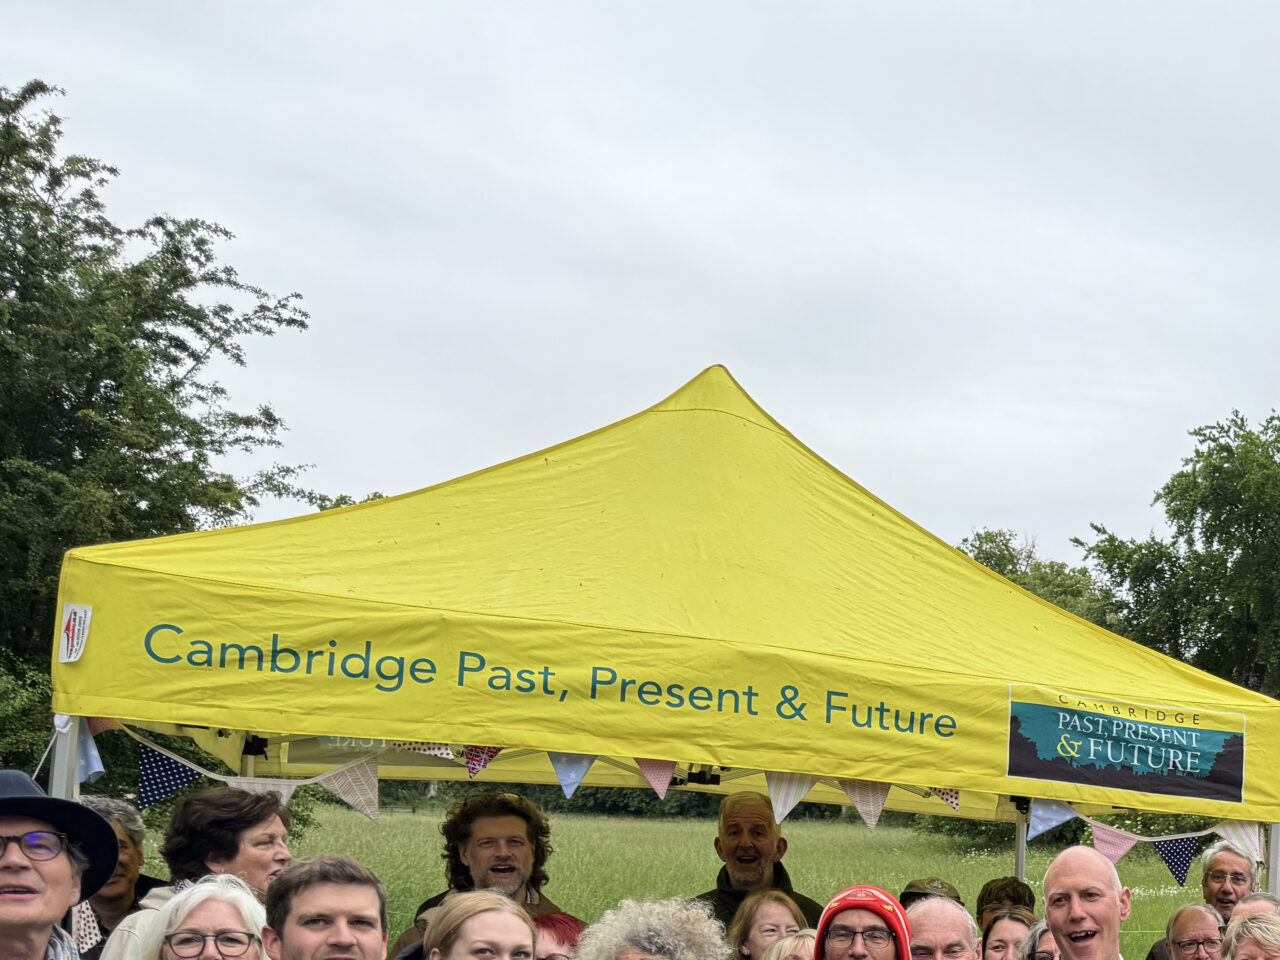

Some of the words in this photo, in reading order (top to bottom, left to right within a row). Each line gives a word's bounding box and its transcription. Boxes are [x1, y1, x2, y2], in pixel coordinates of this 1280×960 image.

[144, 624, 437, 692] Cambridge
[457, 650, 568, 702] Past,
[590, 666, 759, 716] Present
[776, 685, 808, 721] &
[826, 690, 957, 738] Future
[1058, 694, 1200, 725] CAMBRIDGE
[1058, 712, 1108, 738] PAST,
[1112, 720, 1200, 747] PRESENT
[1057, 733, 1082, 758] &
[1088, 738, 1200, 773] FUTURE
